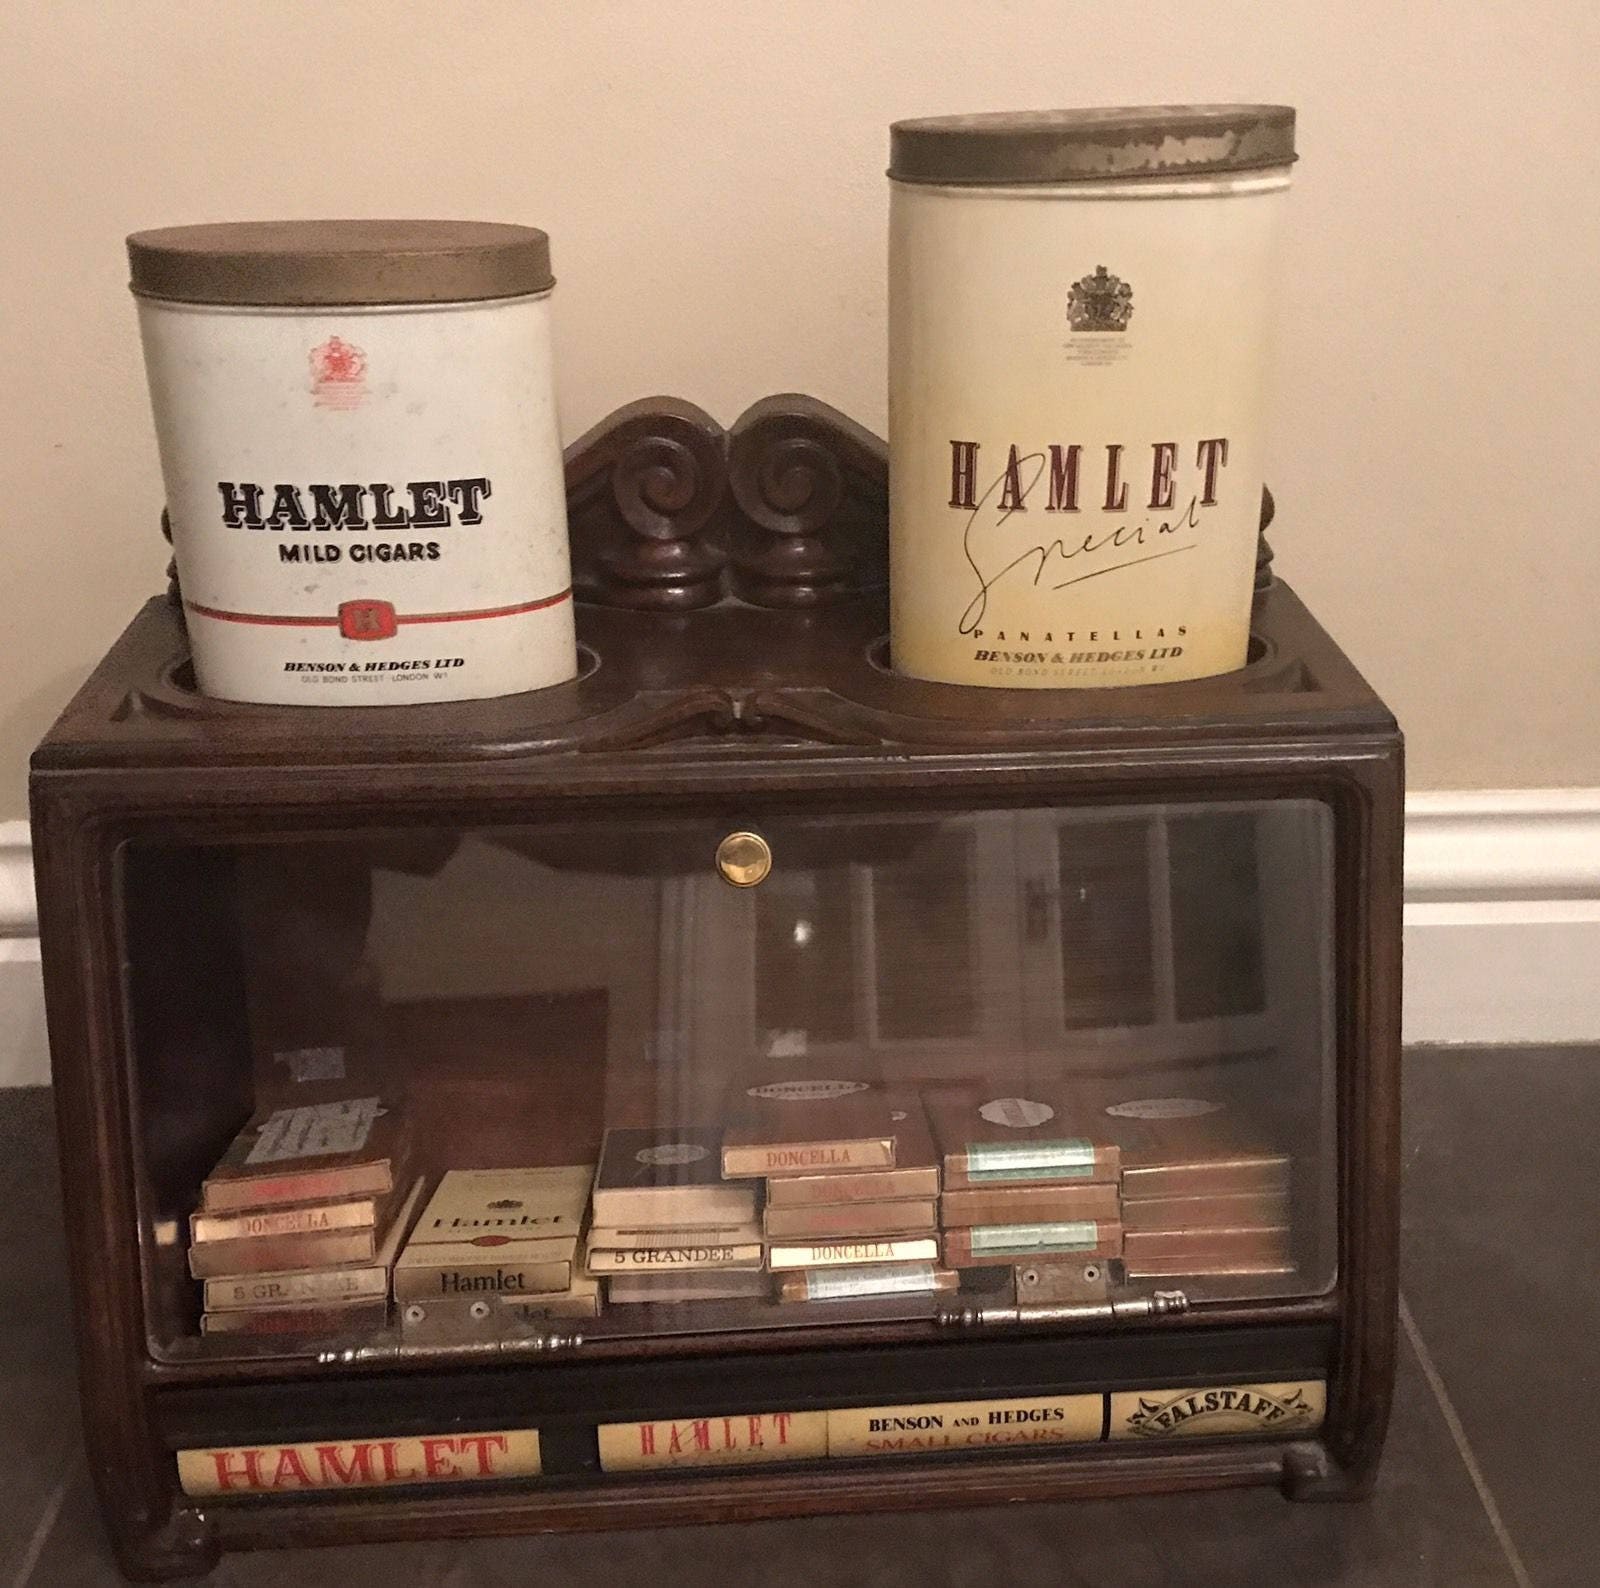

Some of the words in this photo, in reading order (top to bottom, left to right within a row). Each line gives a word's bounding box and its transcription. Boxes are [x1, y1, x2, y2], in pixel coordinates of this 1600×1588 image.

[949, 438, 1228, 513] HAMLET
[218, 478, 492, 531] HAMLET
[279, 543, 341, 562] MILD
[350, 541, 441, 562] CIGARS
[959, 452, 1199, 635] Special
[973, 626, 1187, 642] PANATELLAS
[284, 661, 346, 673] BENSON
[349, 662, 360, 672] &
[365, 659, 430, 671] HEDGES
[434, 658, 464, 669] LTD
[974, 650, 1047, 664] BENSON
[1051, 652, 1065, 664] &
[1069, 650, 1145, 664] HEDGES
[1150, 646, 1183, 660] LTD
[767, 1150, 851, 1167] DONCELLA
[614, 1251, 626, 1265] 5
[632, 1248, 734, 1264] GRANDEE
[812, 1245, 895, 1261] DONCELLA
[440, 1269, 526, 1293] Hamlet
[869, 1415, 944, 1432] BENSON
[953, 1416, 980, 1428] AND
[988, 1408, 1065, 1425] HEDGES
[1154, 1391, 1286, 1429] FALSTAFF
[639, 1413, 792, 1456] HAMLET
[864, 1434, 950, 1451] SMALL
[965, 1427, 1065, 1445] CIGARS
[207, 1435, 509, 1490] HAMLET
